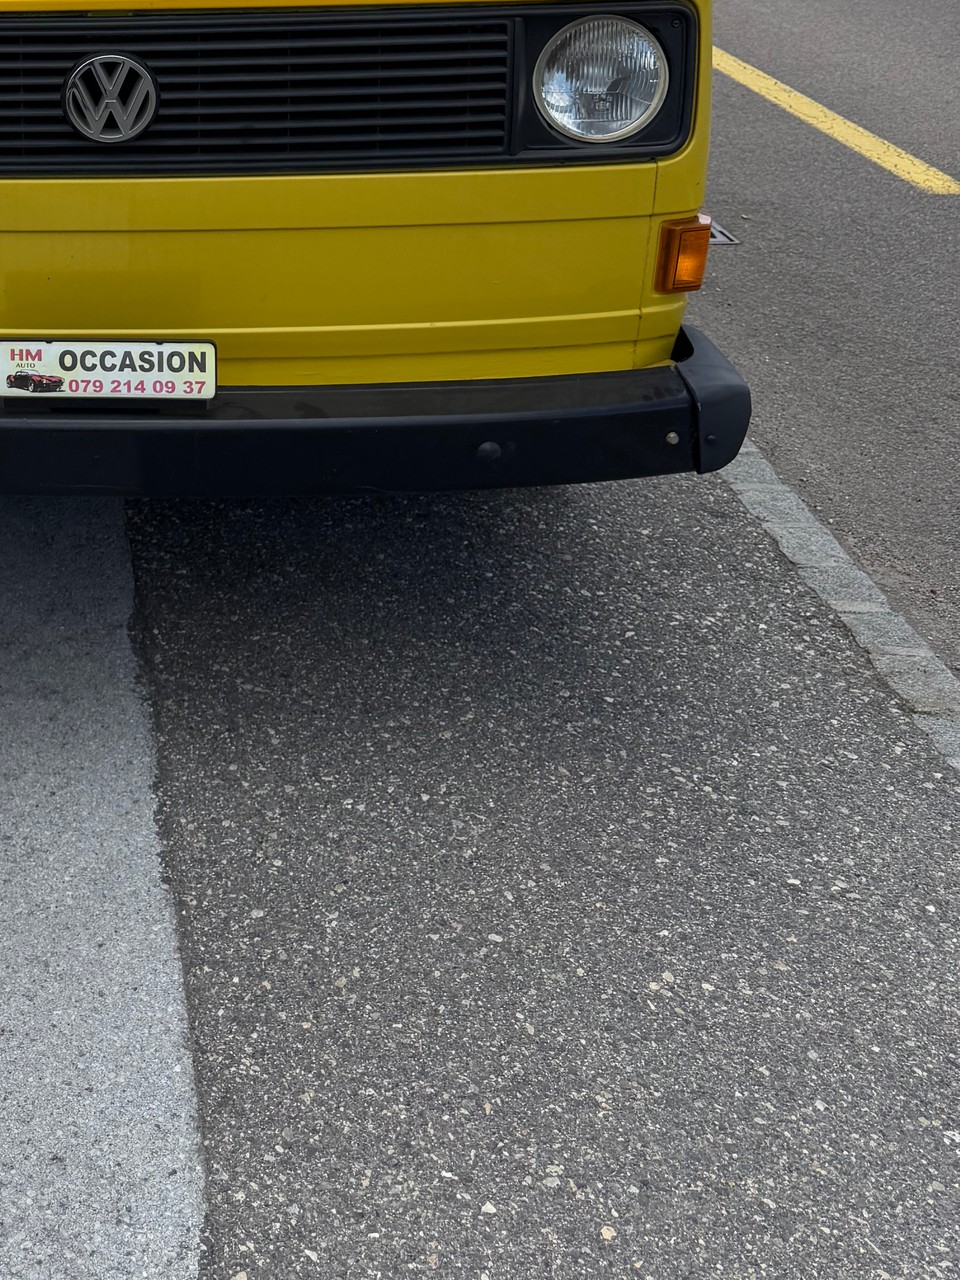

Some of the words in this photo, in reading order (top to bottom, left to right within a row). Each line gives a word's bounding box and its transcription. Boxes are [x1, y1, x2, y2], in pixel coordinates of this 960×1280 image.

[10, 348, 43, 361] HM
[58, 349, 207, 373] OCCASION
[68, 379, 104, 393] 079
[110, 379, 146, 394] 214
[152, 380, 176, 394] 09
[183, 381, 207, 394] 37
